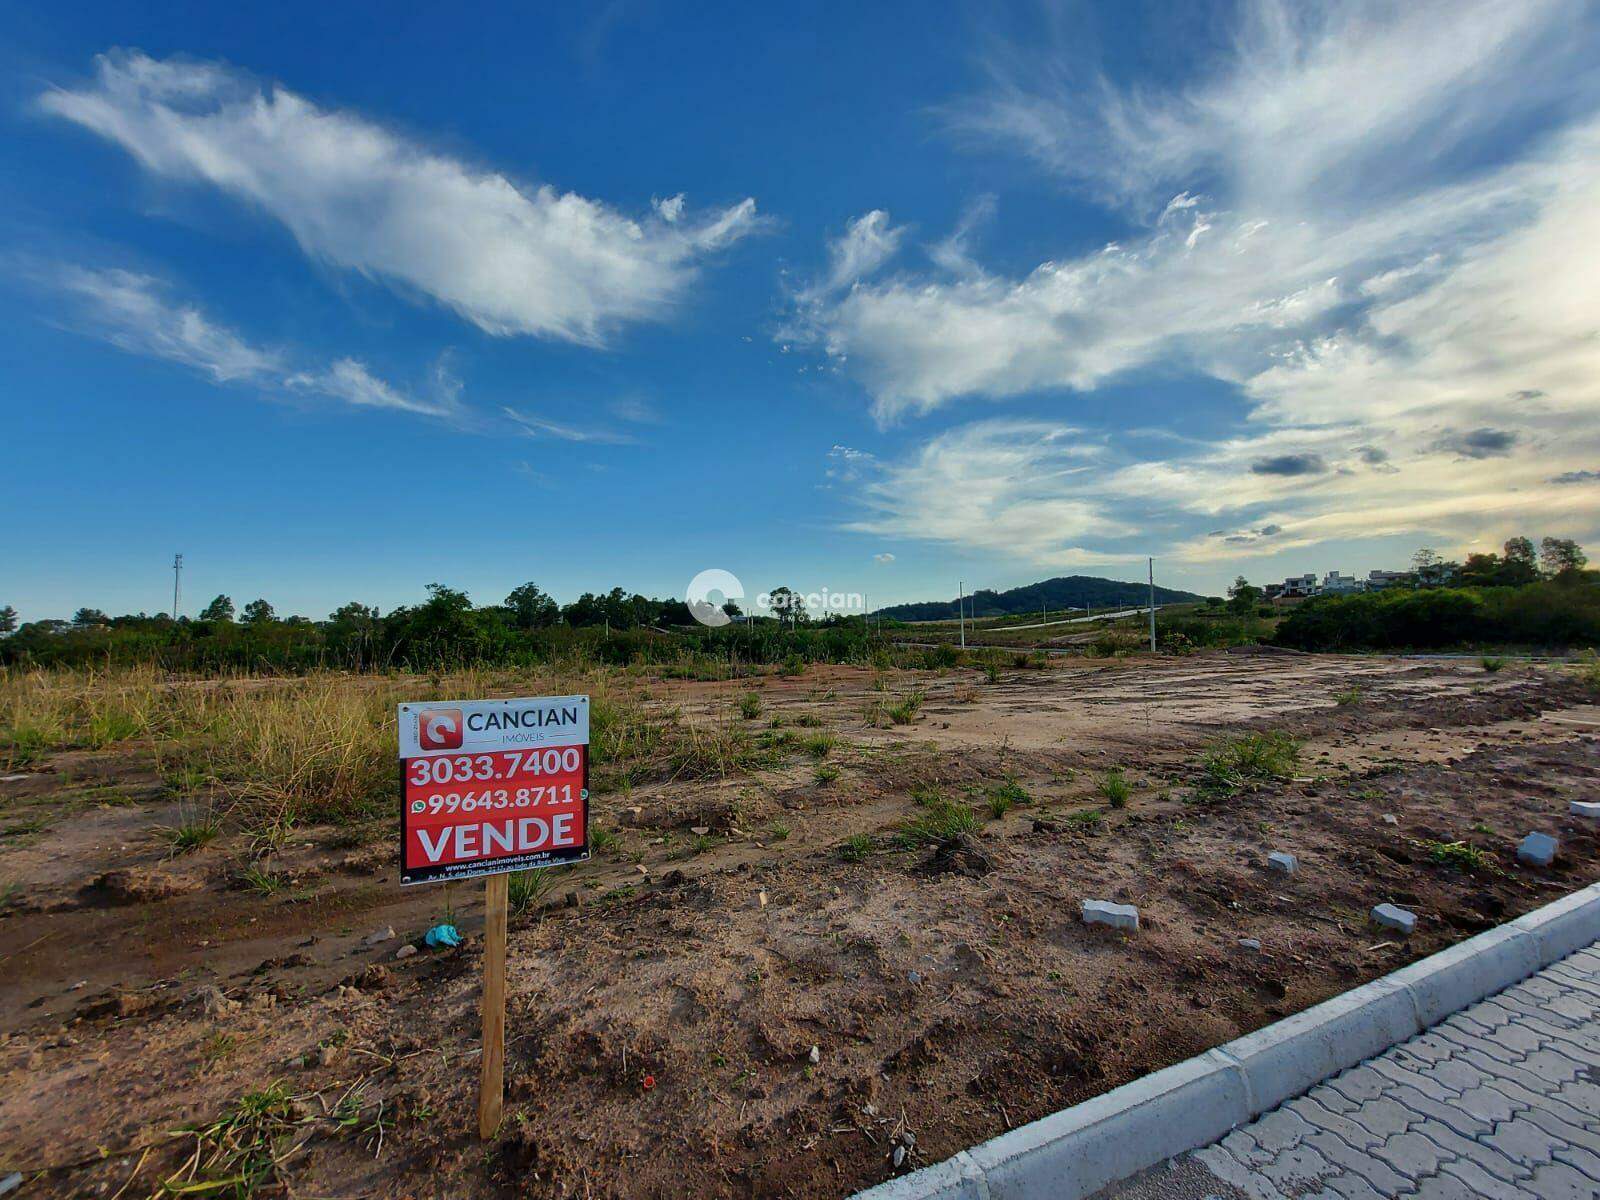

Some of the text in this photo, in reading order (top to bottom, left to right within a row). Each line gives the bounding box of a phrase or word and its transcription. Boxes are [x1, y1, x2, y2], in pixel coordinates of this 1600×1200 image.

[467, 707, 577, 732] CANCIAN
[502, 732, 545, 744] IMÓVEIS
[410, 748, 580, 786] 3033.7400
[428, 784, 574, 815] 99643.8711
[416, 813, 575, 862] VENDE
[445, 851, 551, 872] www.cancianimoveis.com.br
